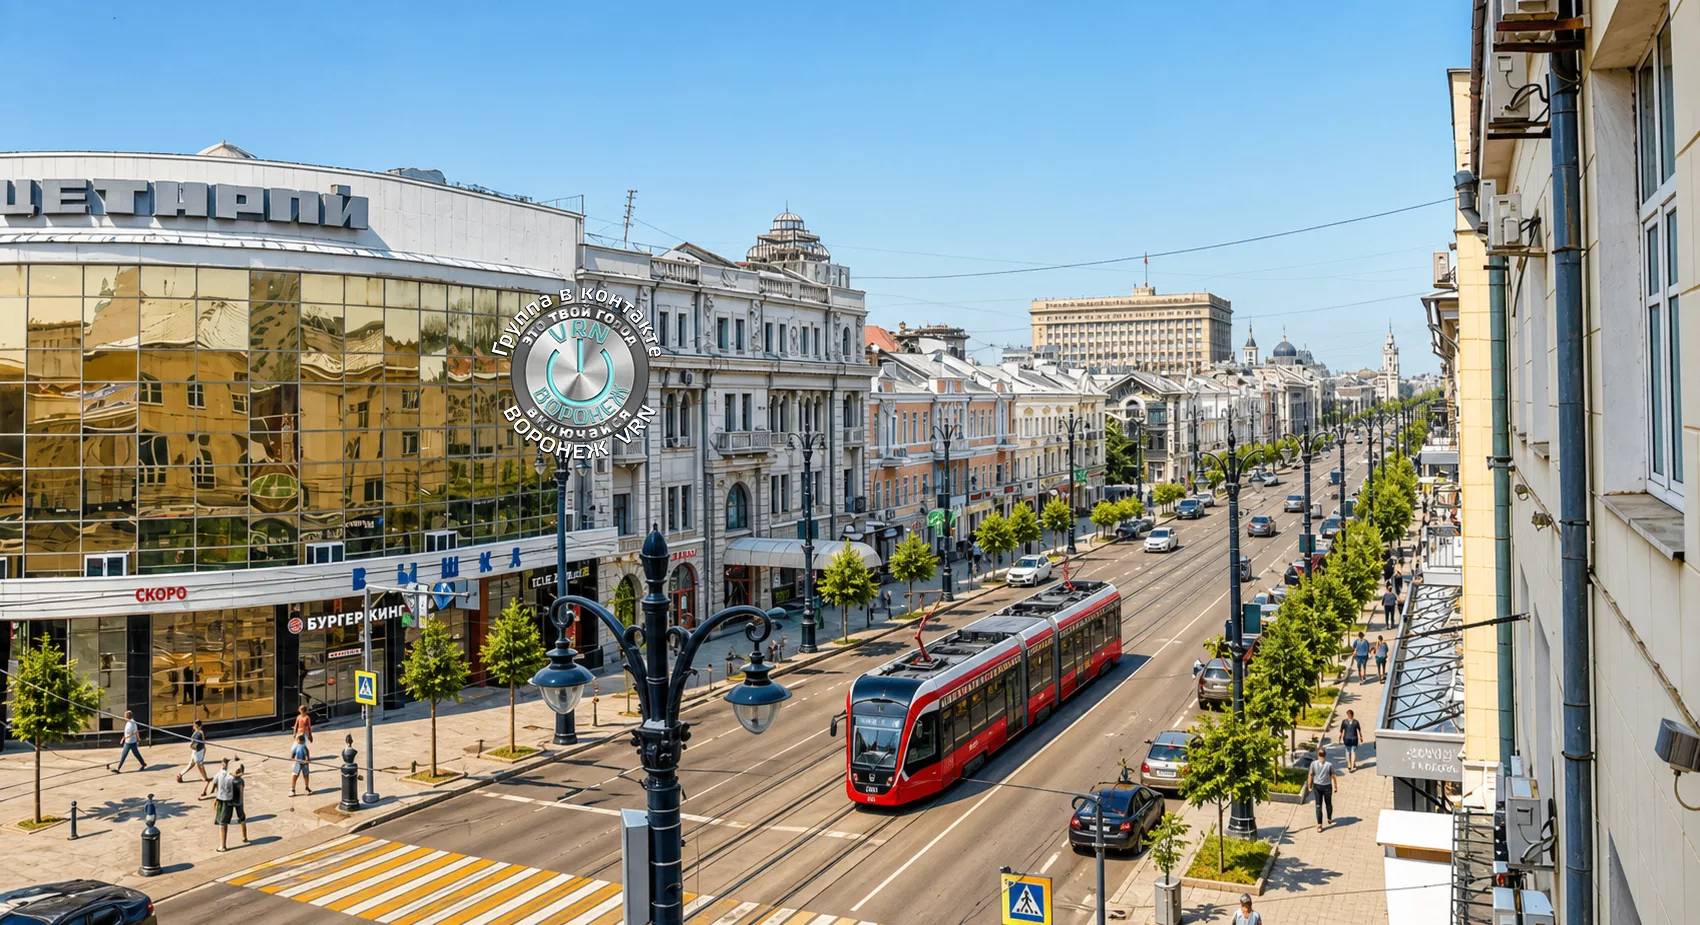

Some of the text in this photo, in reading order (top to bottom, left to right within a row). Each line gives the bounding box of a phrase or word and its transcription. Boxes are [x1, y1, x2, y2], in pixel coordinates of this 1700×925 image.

[135, 586, 187, 602] СКОРО
[307, 611, 364, 631] БУРГЕР
[369, 604, 406, 622] КИНГ
